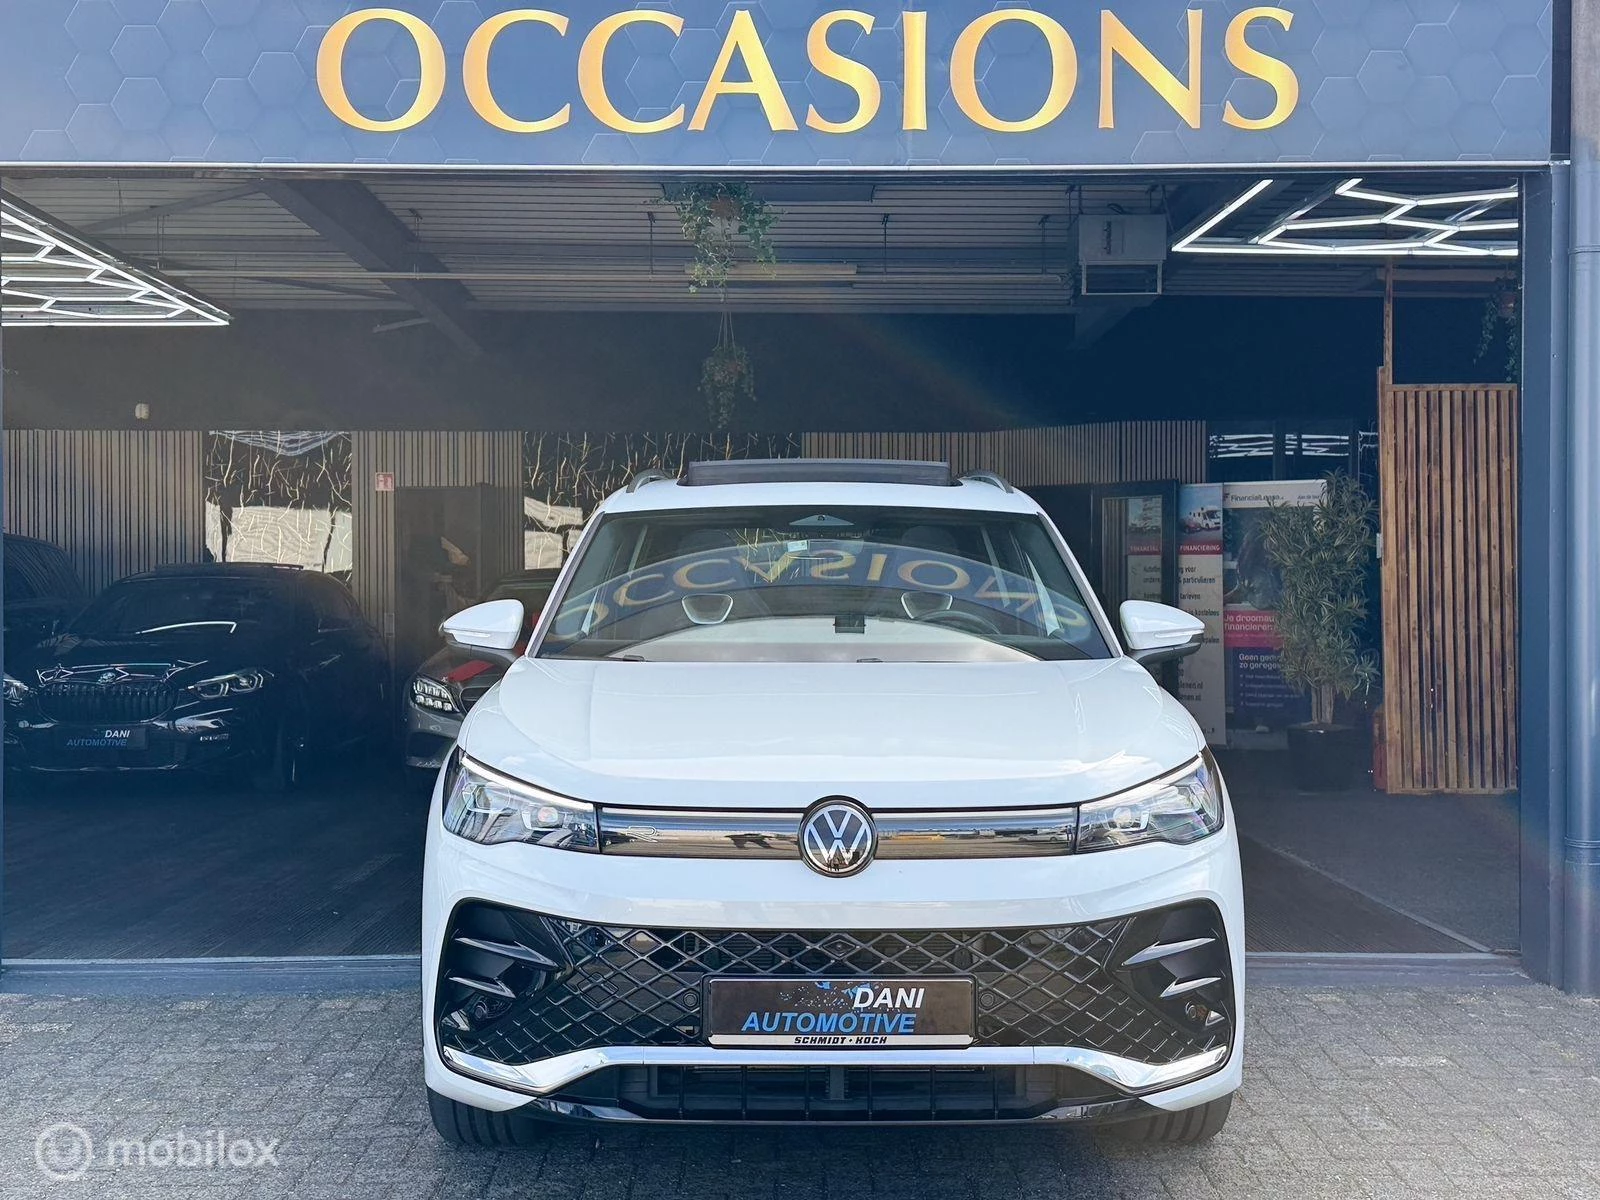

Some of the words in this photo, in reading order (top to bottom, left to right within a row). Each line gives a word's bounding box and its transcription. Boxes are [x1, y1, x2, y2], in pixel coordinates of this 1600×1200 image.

[316, 7, 1300, 133] OCCASIONS
[1224, 614, 1234, 622] Je
[1235, 614, 1276, 622] droomau
[1238, 653, 1259, 661] Geen
[104, 729, 131, 738] DANI
[66, 738, 128, 747] AUTOMOTIVE
[853, 987, 925, 1009] DANI
[741, 1012, 917, 1033] AUTOMOTIVE
[794, 1036, 847, 1045] SCHMIDT
[855, 1036, 888, 1045] KOCH
